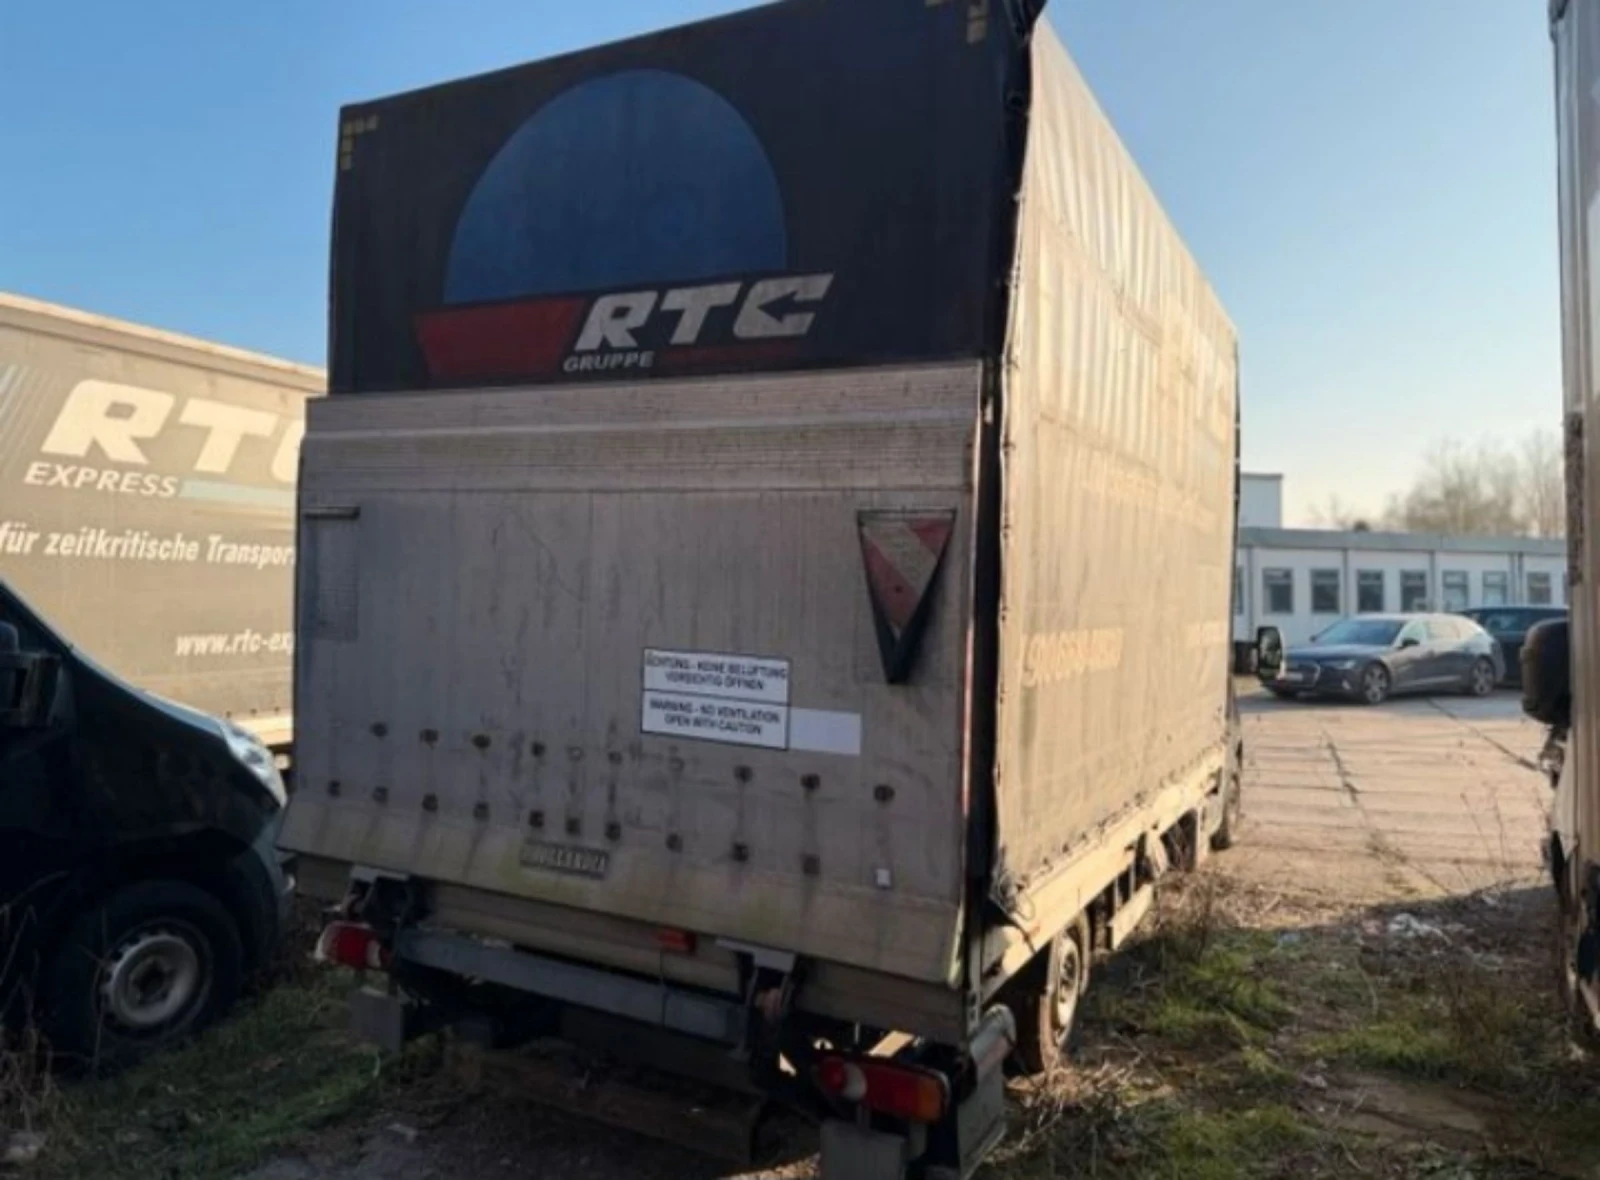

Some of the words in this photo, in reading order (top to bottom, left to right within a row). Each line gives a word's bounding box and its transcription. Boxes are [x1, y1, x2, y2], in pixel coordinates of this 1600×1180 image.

[574, 272, 835, 350] RTC
[563, 350, 654, 373] GRUPPE
[24, 461, 179, 498] EXPRESS
[0, 520, 40, 555] für
[43, 526, 200, 562] zeitkritische
[206, 534, 295, 570] Transpor
[650, 699, 692, 714] WARNING
[700, 703, 716, 715] NO
[717, 706, 780, 723] VENTILATION
[664, 712, 690, 727] OPEN
[719, 719, 761, 735] CAUTION
